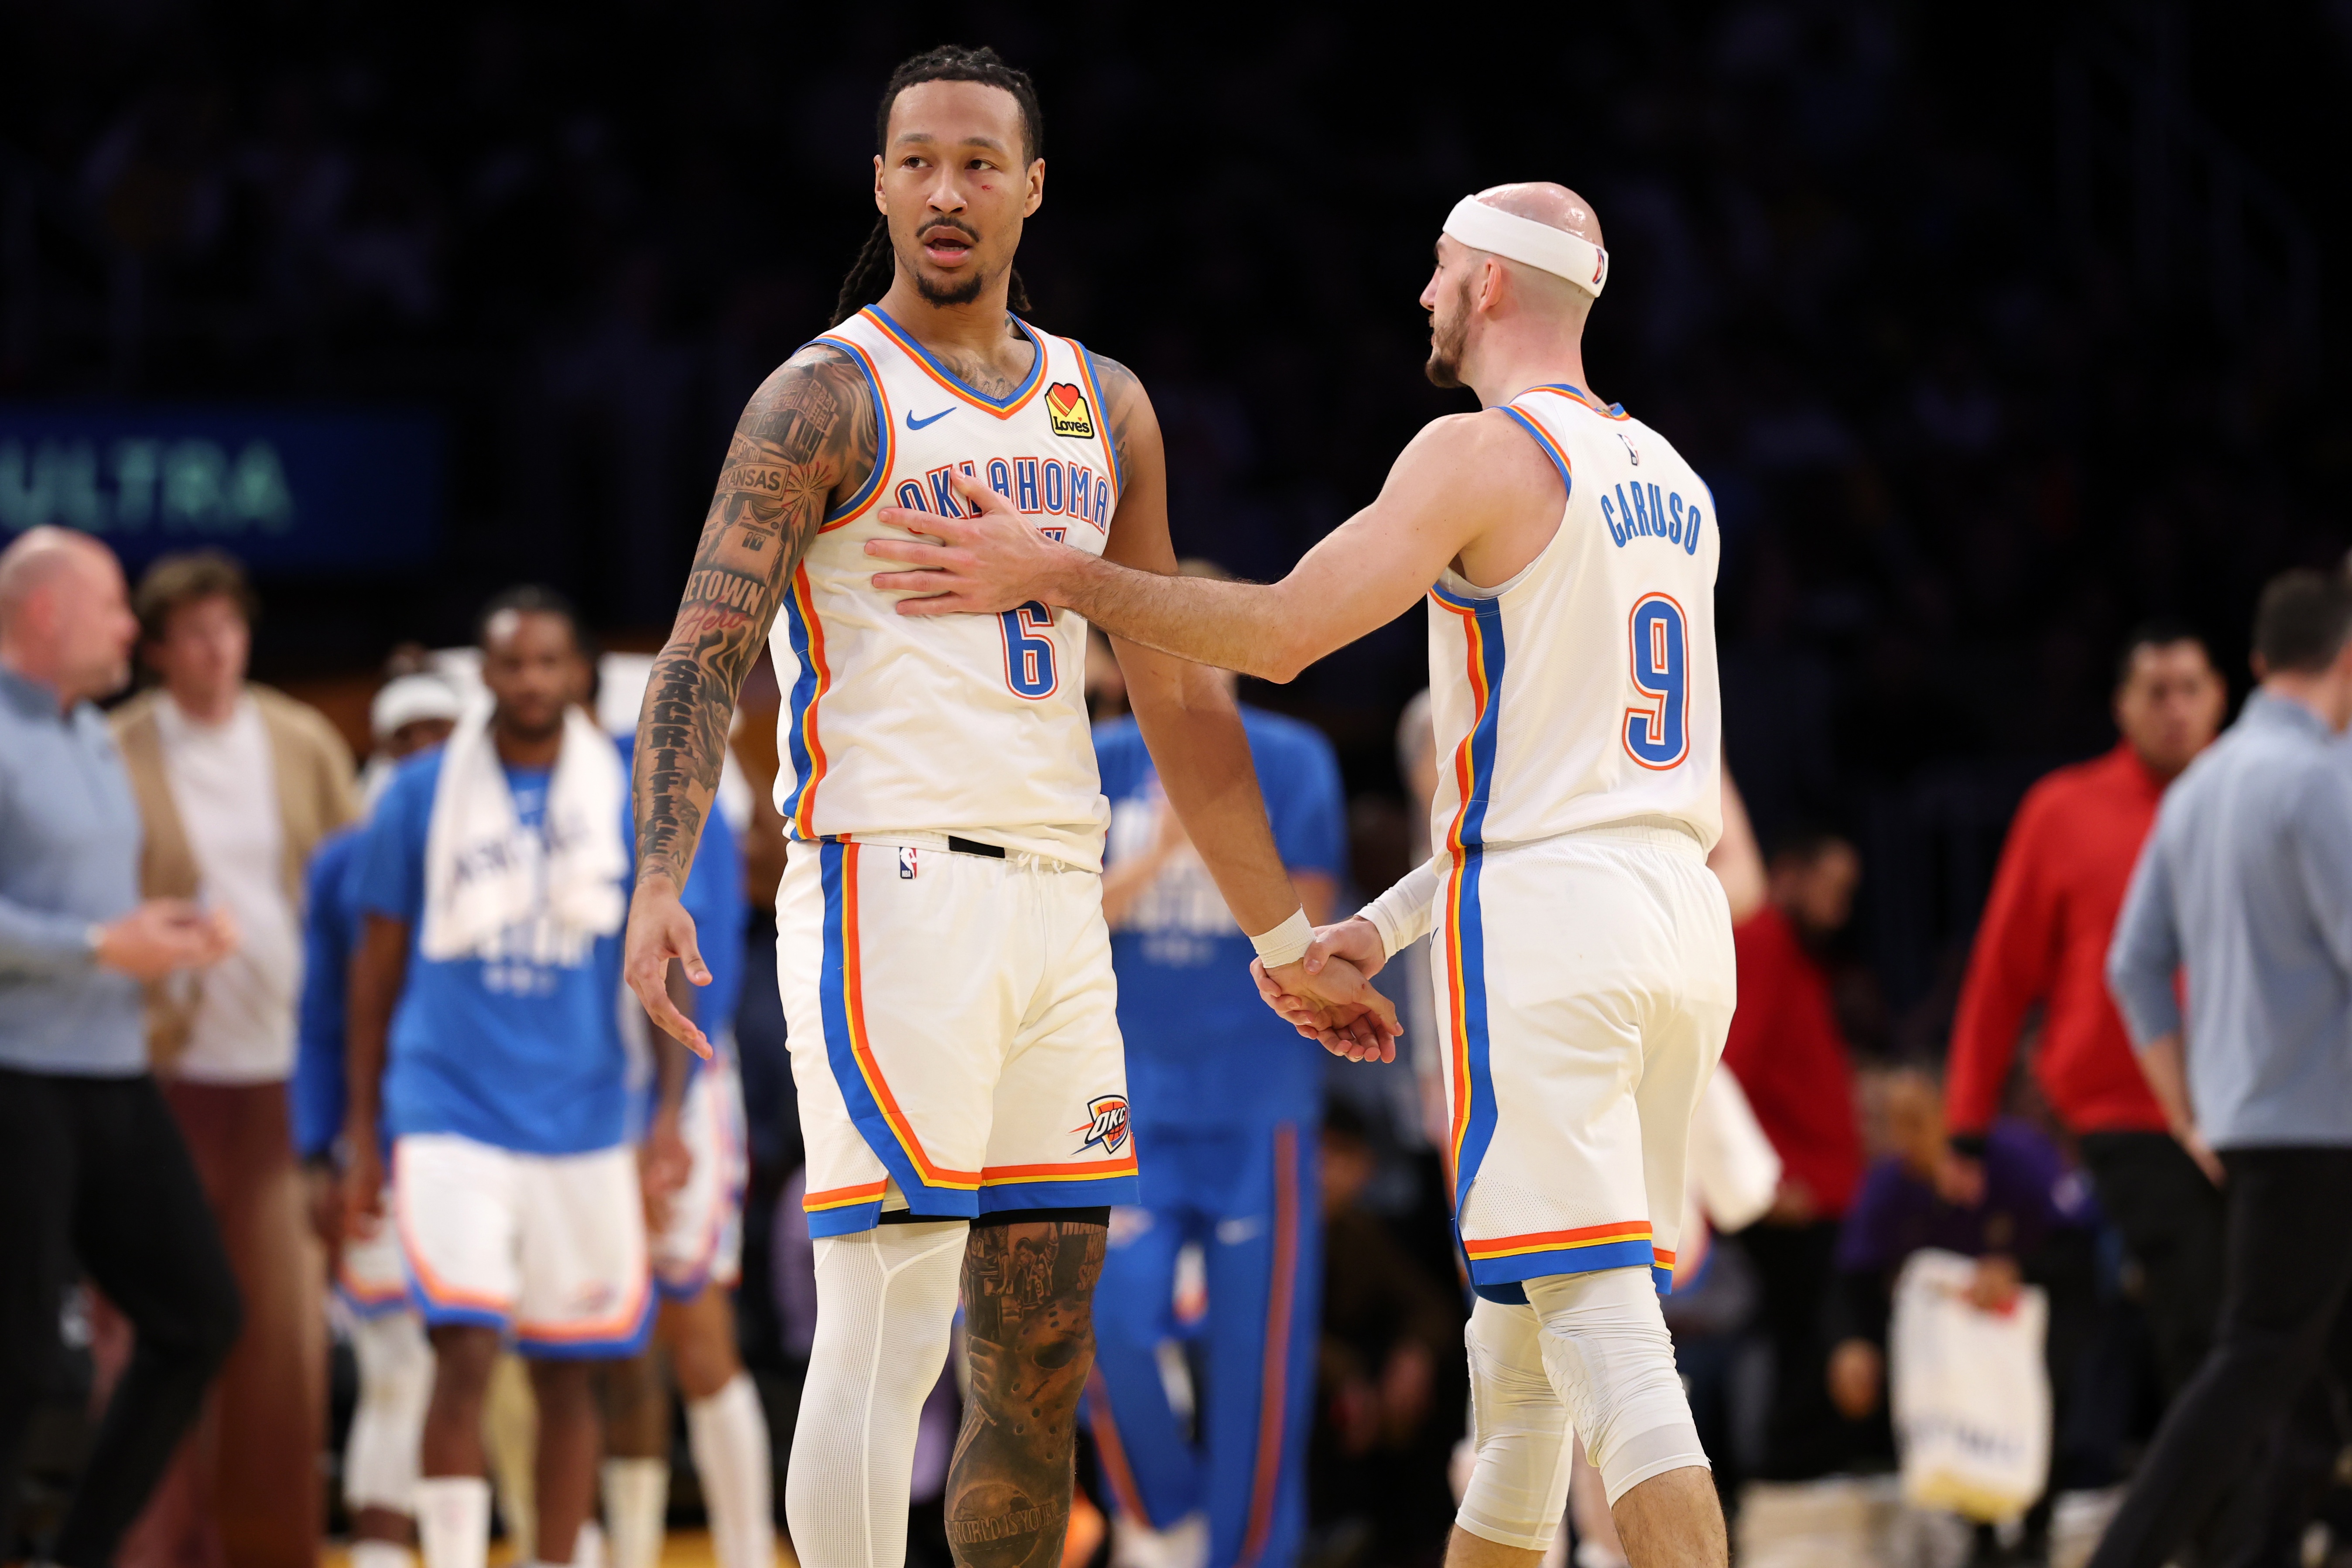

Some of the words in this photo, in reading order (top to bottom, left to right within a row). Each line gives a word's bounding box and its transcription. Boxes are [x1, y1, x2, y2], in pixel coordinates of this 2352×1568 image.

[0, 438, 293, 534] ULTRA
[1601, 480, 1701, 556] CARUSO
[997, 600, 1058, 700] 6
[1622, 592, 1690, 770] 9
[1086, 1106, 1126, 1142] OKC
[952, 1517, 1001, 1543] WORLD
[1003, 1513, 1018, 1537] IS
